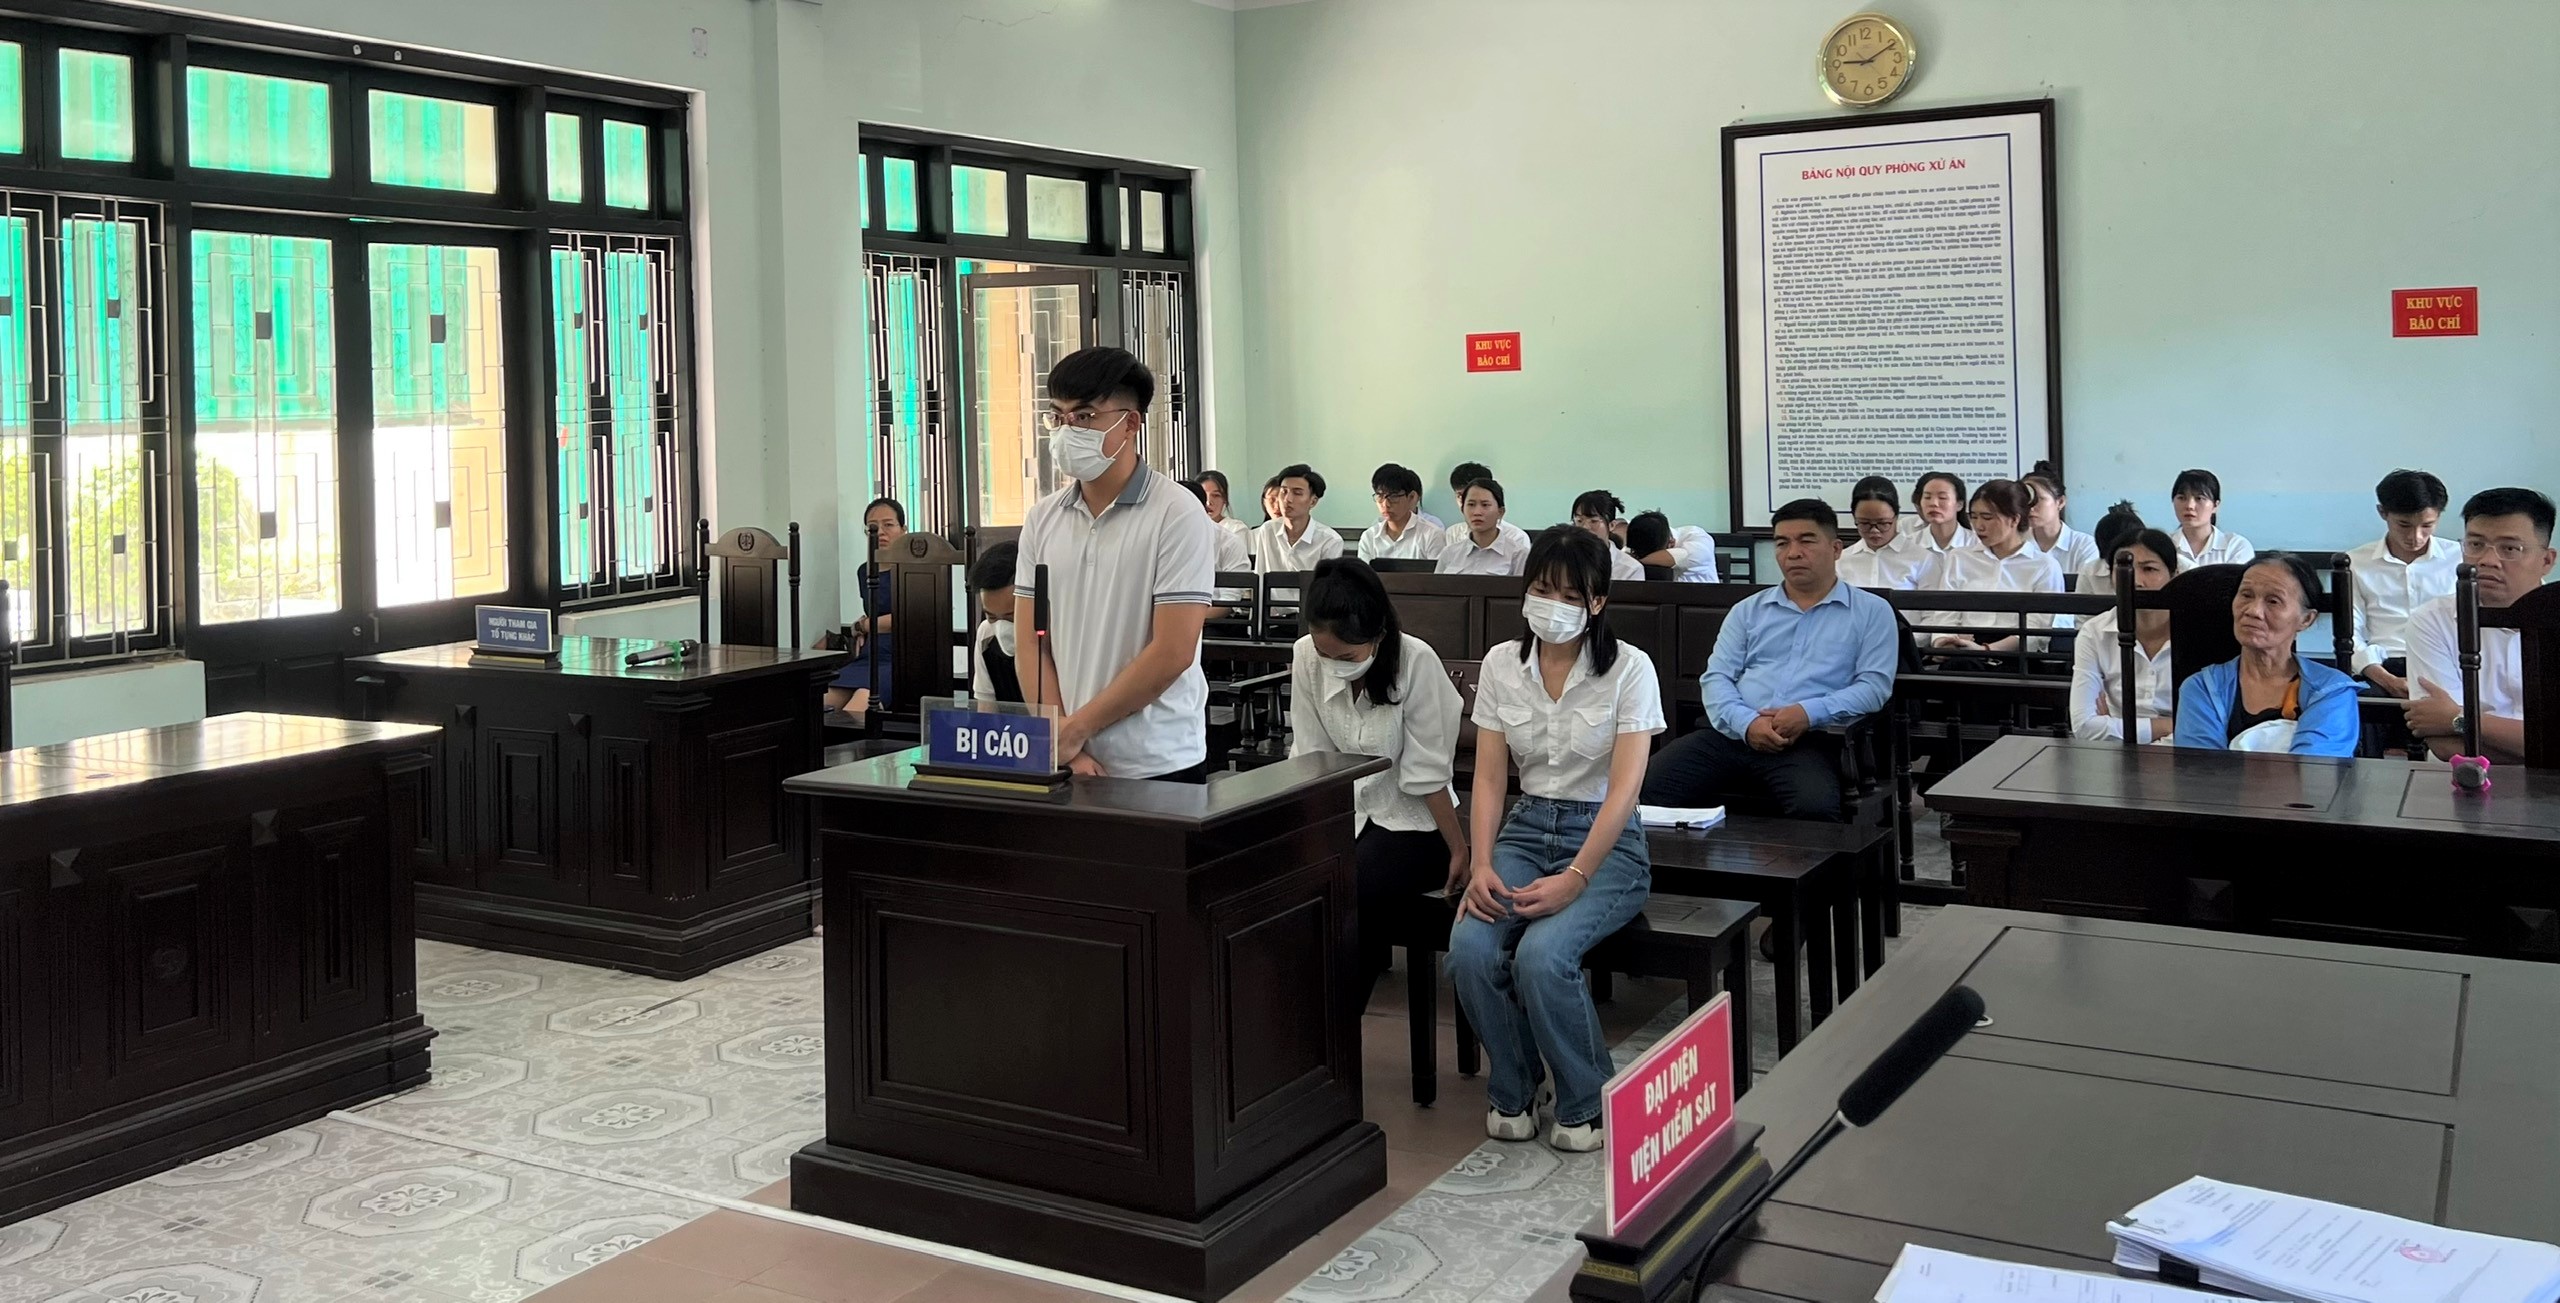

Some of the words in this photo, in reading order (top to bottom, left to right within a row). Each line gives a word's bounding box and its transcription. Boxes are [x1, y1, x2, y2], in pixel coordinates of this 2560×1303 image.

[1848, 34, 1856, 46] 11
[1860, 27, 1871, 40] 12
[1836, 44, 1847, 57] 10
[1887, 38, 1896, 50] 2
[1893, 51, 1902, 64] 3
[1832, 59, 1841, 71] 9
[1890, 66, 1902, 77] 4
[1837, 72, 1846, 84] 8
[1878, 77, 1888, 89] 5
[1850, 80, 1858, 92] 7
[1864, 84, 1873, 95] 6
[1801, 167, 1832, 180] BẢNG
[1836, 164, 1855, 179] NỘI
[1859, 165, 1882, 176] QUY
[1886, 161, 1925, 174] PHÒNG
[1929, 158, 1946, 171] XỬ
[1949, 157, 1966, 169] ÁN
[2406, 297, 2433, 309] KHU
[2436, 294, 2463, 310] VỰC
[2409, 315, 2434, 330] BÁO
[2438, 313, 2461, 329] CHÍ
[1475, 340, 1492, 350] KHU
[1494, 338, 1511, 351] VỰC
[1477, 354, 1493, 366] BÁO
[1495, 353, 1510, 366] CHÍ
[488, 616, 507, 627] NGƯỜI
[508, 618, 526, 629] THAM
[526, 620, 538, 630] GIA
[491, 627, 500, 639] TỐ
[501, 630, 517, 641] TỤNG
[518, 631, 536, 642] KHÁC
[956, 727, 978, 760] BỊ
[984, 725, 1029, 759] CÁO
[1644, 1069, 1668, 1116] ĐẠI
[1670, 1044, 1698, 1092] DIỆN
[1630, 1132, 1660, 1186] VIỆN
[1662, 1099, 1694, 1156] KIỂM
[1695, 1081, 1718, 1126] SÁT
